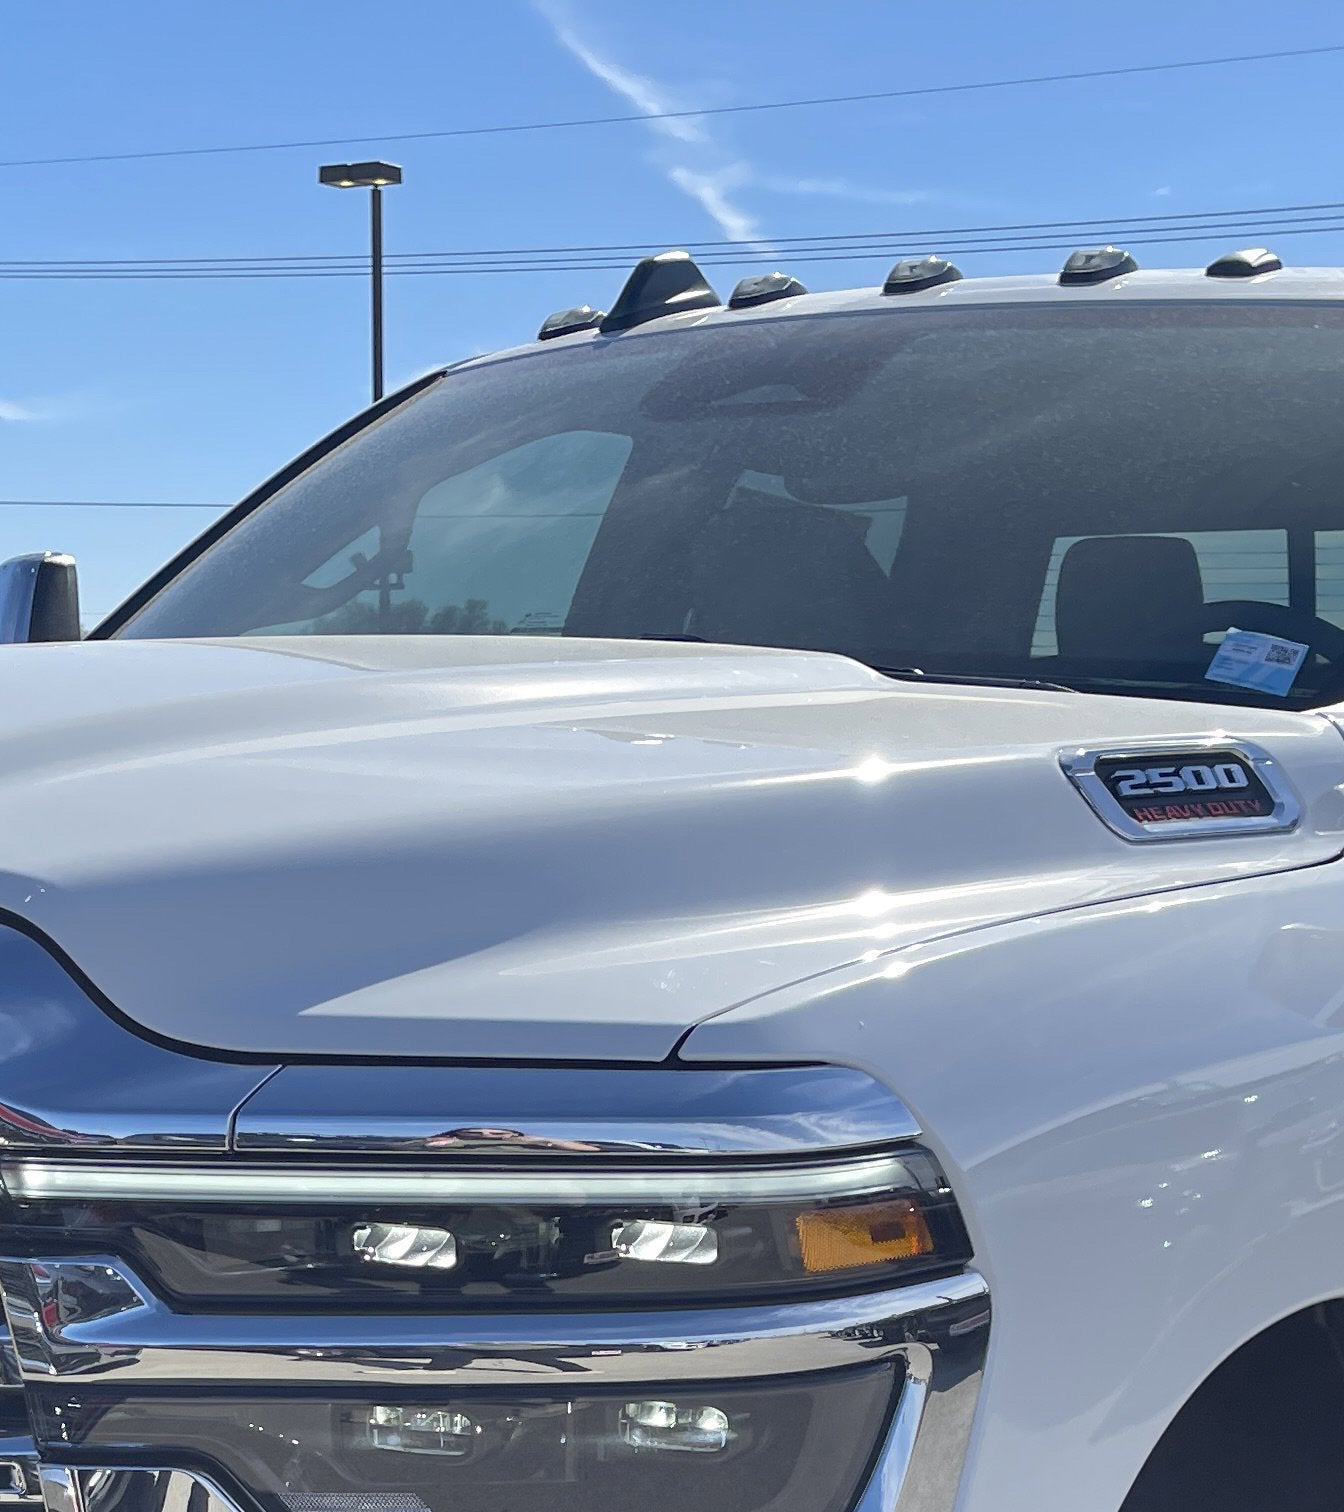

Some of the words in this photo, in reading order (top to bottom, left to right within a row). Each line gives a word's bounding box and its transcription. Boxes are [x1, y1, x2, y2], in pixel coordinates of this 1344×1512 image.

[1110, 762, 1250, 797] 2500
[1133, 803, 1206, 824] HEAVY
[1206, 799, 1262, 817] DUTY
